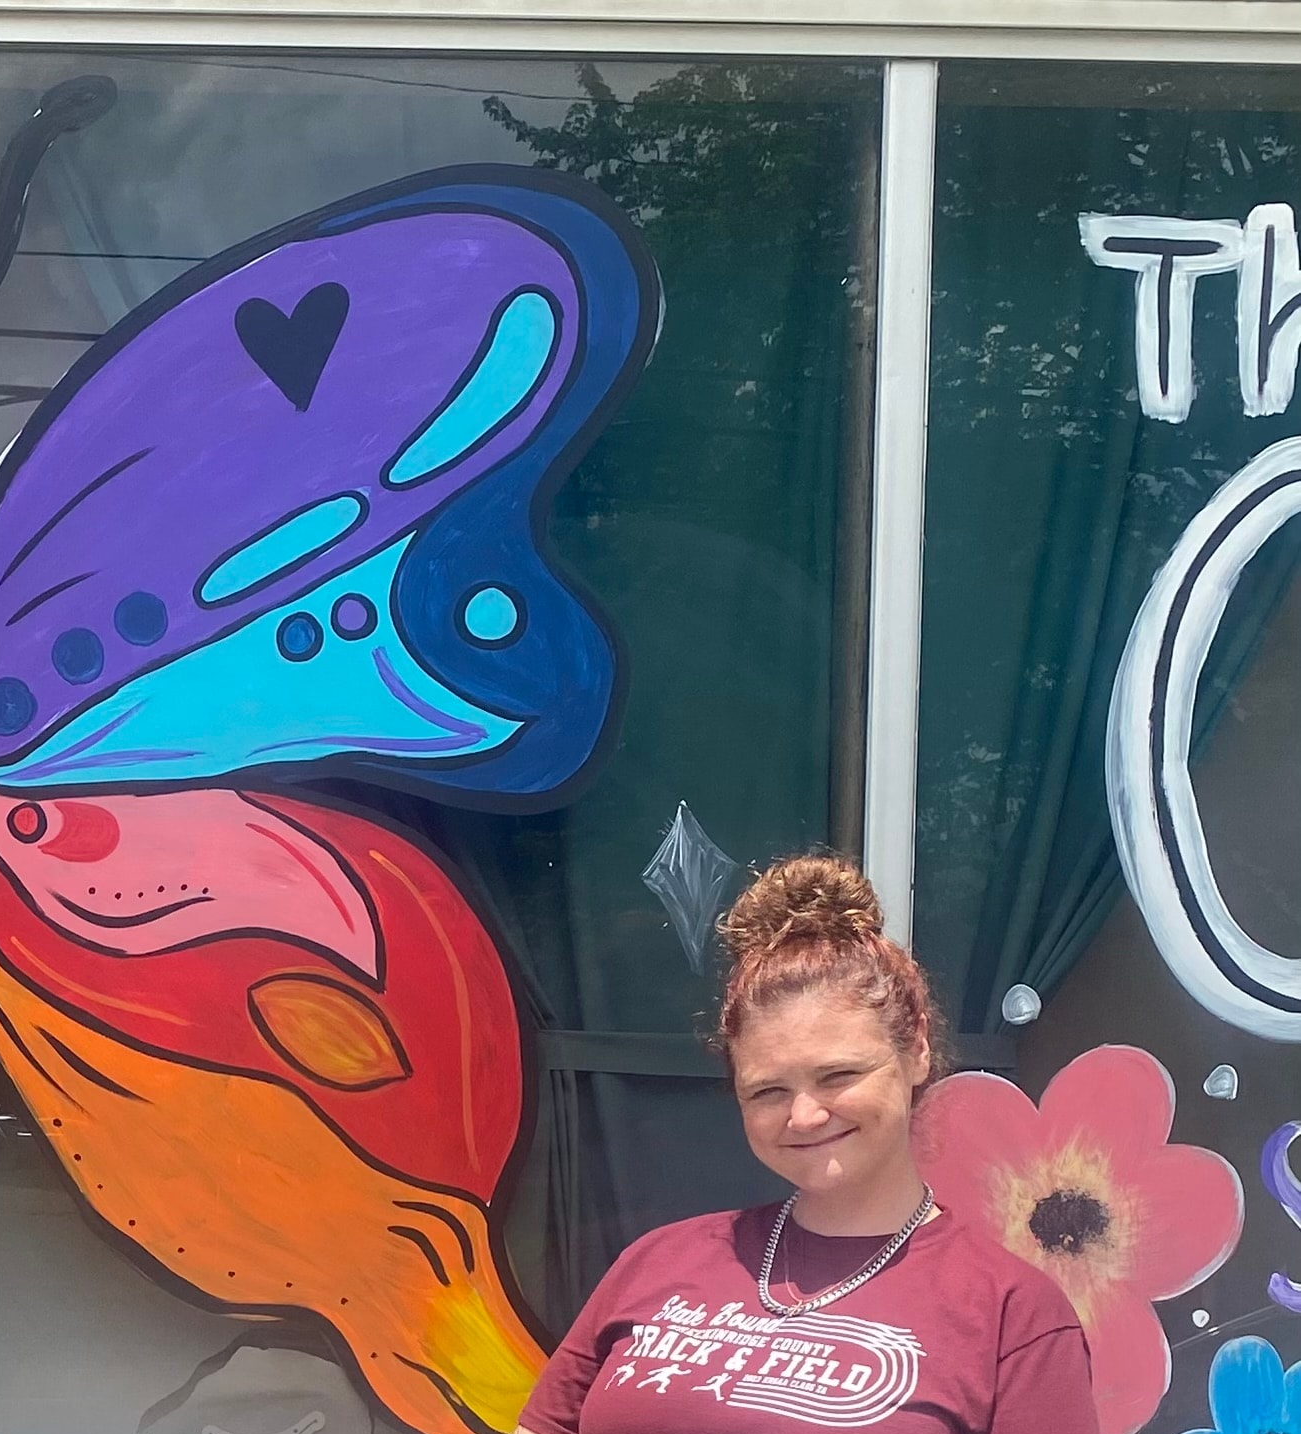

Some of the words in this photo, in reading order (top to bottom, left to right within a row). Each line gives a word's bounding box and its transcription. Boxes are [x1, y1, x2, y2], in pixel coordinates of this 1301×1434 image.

[651, 1294, 708, 1327] State
[708, 1301, 784, 1334] Bound
[622, 1324, 724, 1366] TRACK
[724, 1347, 753, 1371] &
[757, 1350, 872, 1393] FIELD
[770, 1336, 837, 1358] COUNTY
